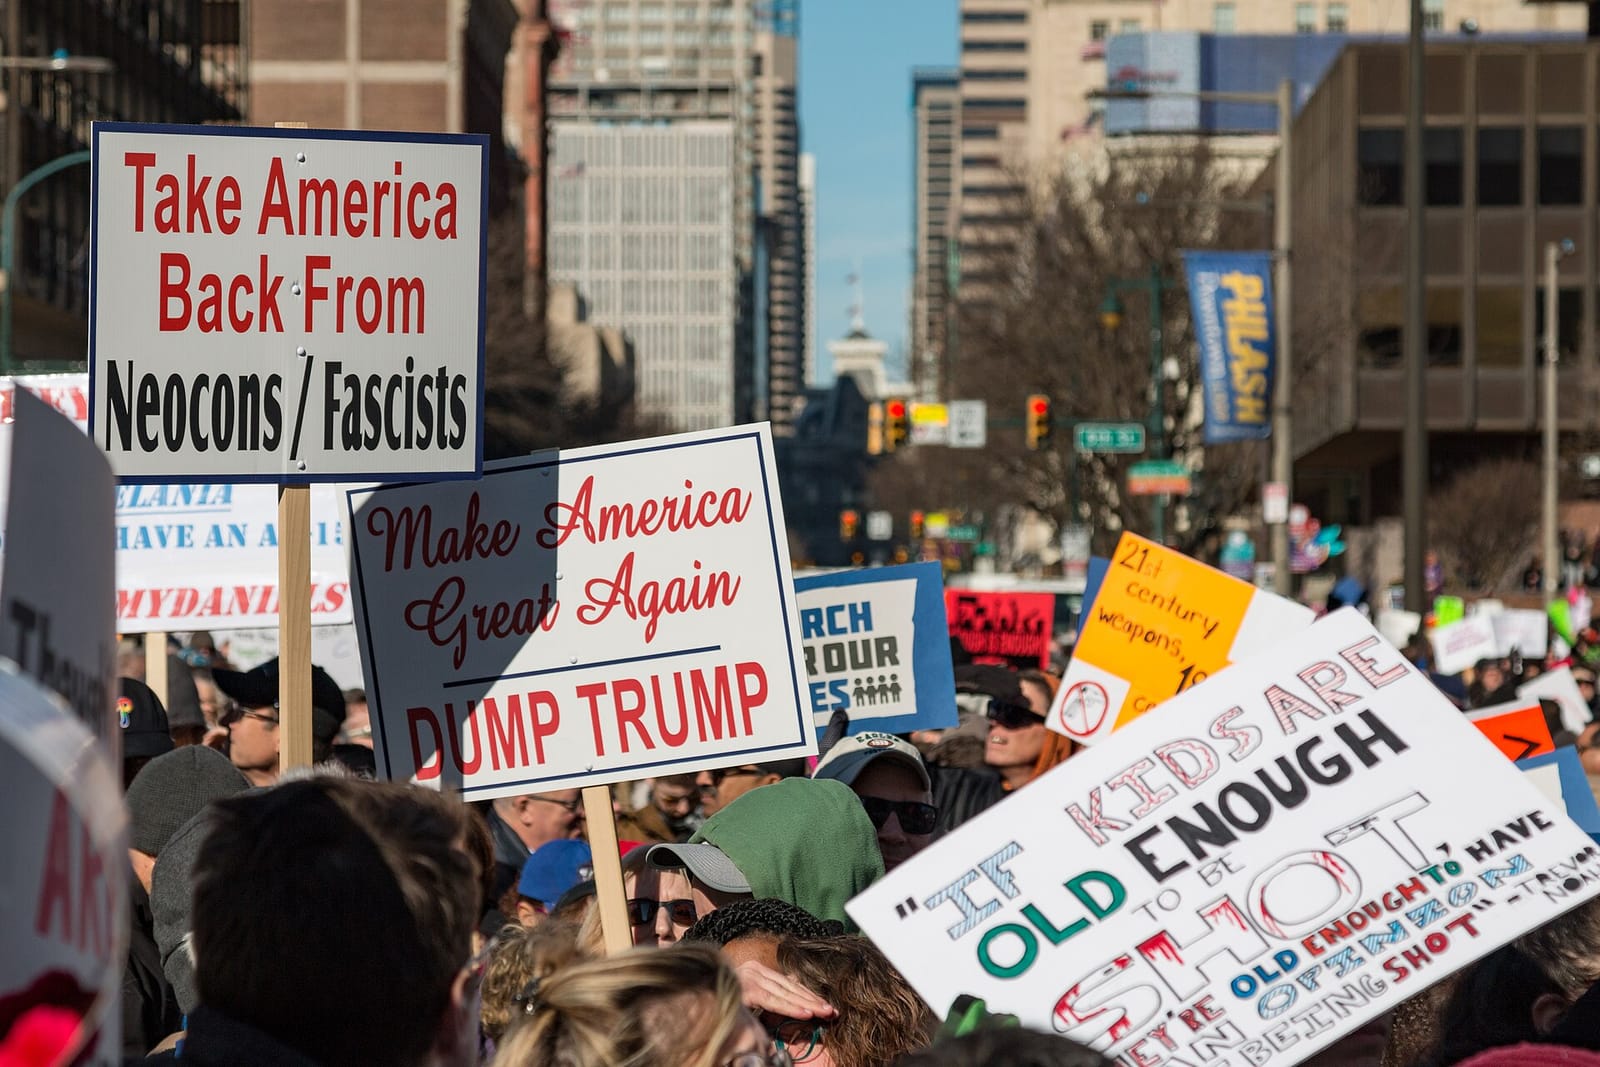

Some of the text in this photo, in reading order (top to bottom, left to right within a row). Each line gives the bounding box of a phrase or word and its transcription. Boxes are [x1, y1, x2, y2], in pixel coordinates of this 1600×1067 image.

[124, 152, 458, 240] Take America
[159, 252, 425, 335] Back From
[105, 359, 283, 452] Neocons
[289, 355, 314, 461] /
[323, 356, 467, 451] Fascists
[205, 523, 247, 547] AN
[367, 475, 752, 572] Make America
[1120, 540, 1164, 579] 21st
[116, 582, 348, 619] MYDANILS
[404, 551, 741, 670] Great Again
[1099, 607, 1186, 662] weapons,
[1126, 581, 1220, 640] century
[823, 636, 900, 673] OUR
[406, 661, 769, 780] DUMP TRUMP
[895, 635, 1409, 942] "IF KIDS ARE
[976, 708, 1410, 979] OLD ENOUGH
[1131, 852, 1246, 921] TO BE
[1112, 809, 1555, 1067] EY'RE OLD ENOUGH TO HAVE
[1239, 899, 1495, 1067] BEING SHOT"
[1258, 854, 1534, 1020] OPINION
